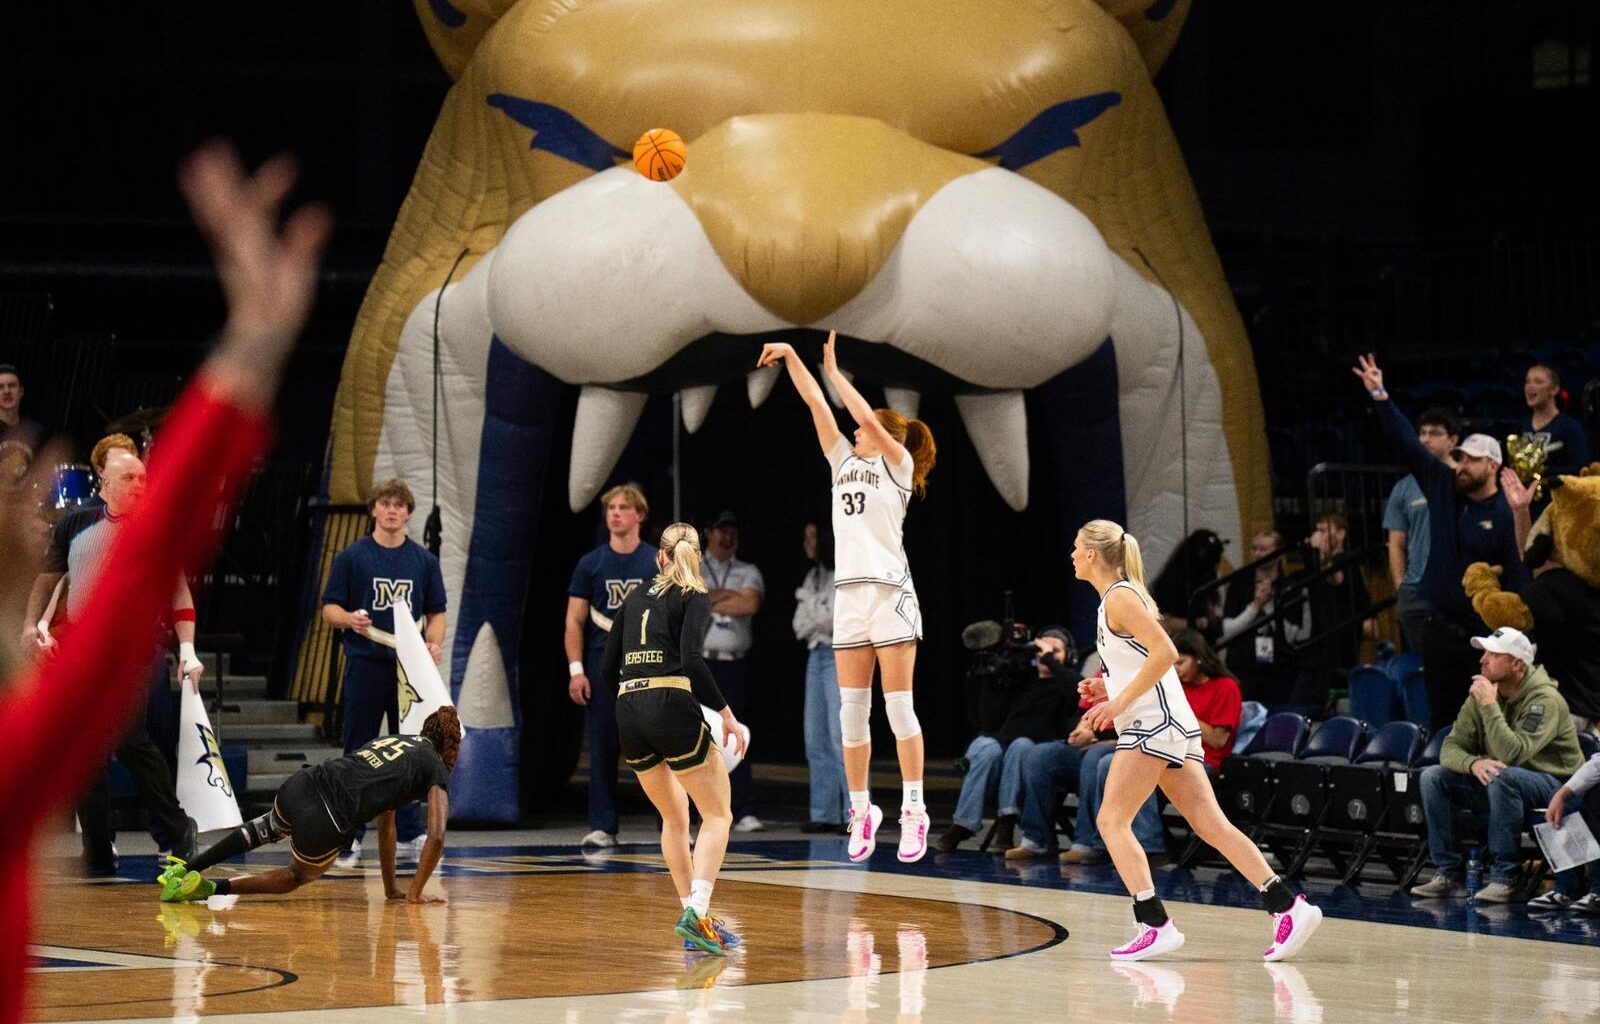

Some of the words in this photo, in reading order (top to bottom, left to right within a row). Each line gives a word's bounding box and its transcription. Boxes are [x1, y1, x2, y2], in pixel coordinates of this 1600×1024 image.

[860, 469, 880, 490] STATE
[841, 491, 866, 516] 33
[373, 577, 413, 611] M
[605, 579, 643, 609] M
[640, 609, 650, 645] 1
[371, 737, 415, 761] 45
[1242, 793, 1249, 807] 5
[1353, 802, 1361, 819] 7
